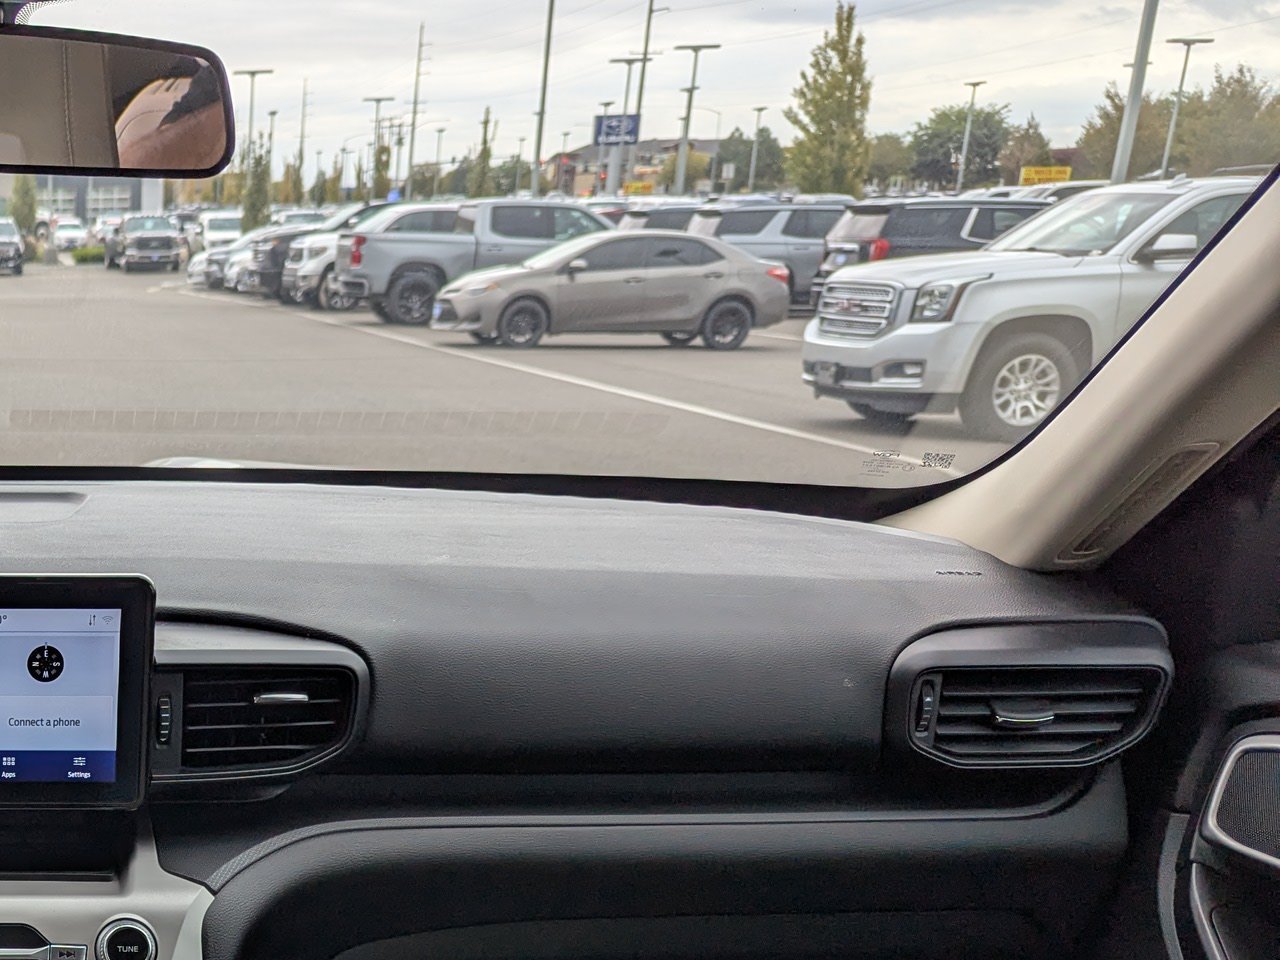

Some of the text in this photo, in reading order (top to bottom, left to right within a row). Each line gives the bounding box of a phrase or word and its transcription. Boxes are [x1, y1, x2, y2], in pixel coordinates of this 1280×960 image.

[8, 717, 81, 728] Connect a phone
[1, 771, 16, 779] Apps
[67, 770, 91, 779] Settings
[117, 945, 139, 953] TUNE
